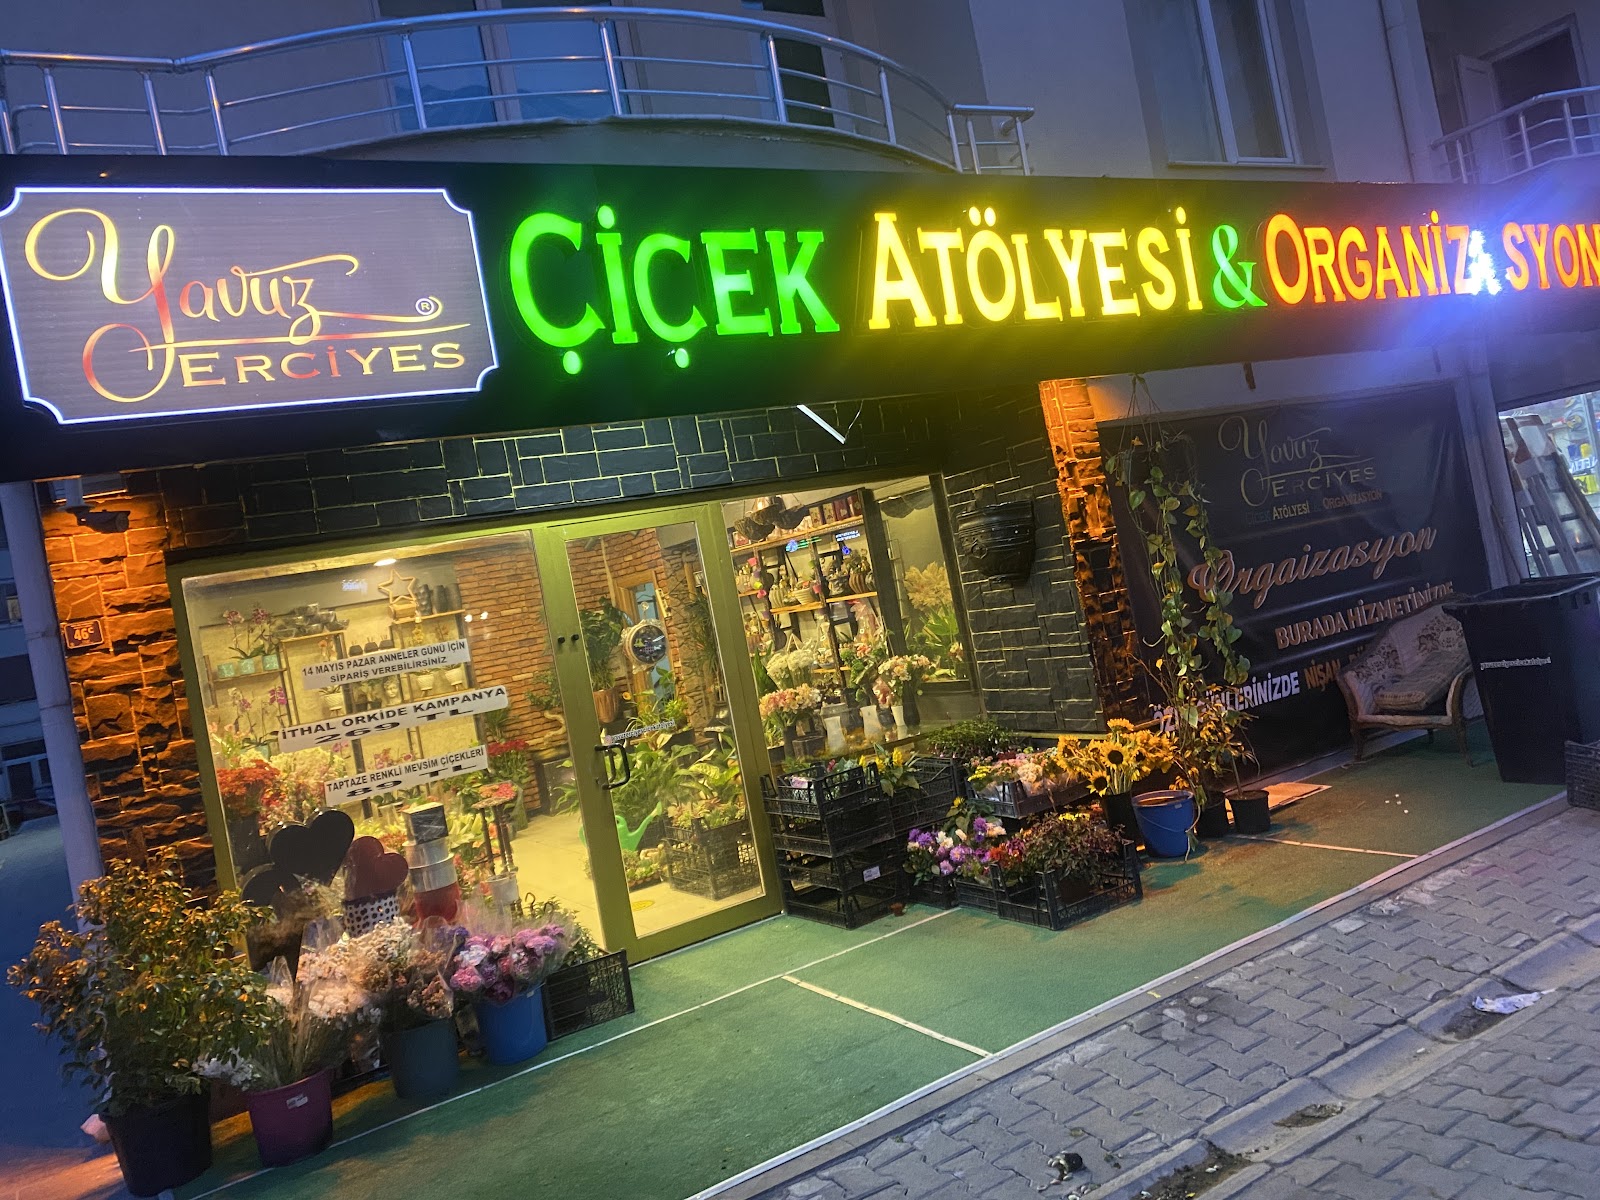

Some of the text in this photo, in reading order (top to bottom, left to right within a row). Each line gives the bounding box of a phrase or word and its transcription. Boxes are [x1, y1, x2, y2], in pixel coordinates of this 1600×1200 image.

[25, 208, 358, 402] Yavuz
[510, 205, 840, 374] ÇİÇEK
[869, 206, 1203, 330] ATÖLYESİ
[1211, 224, 1268, 309] &
[180, 342, 465, 388] ERCİYES
[1272, 466, 1377, 499] ERCİYES
[1187, 526, 1438, 610] Orgaizasyon
[1275, 581, 1454, 650] BURADA HİZMETİNİZDE
[302, 640, 466, 677] 14 MAYIS PAZAR ANNELER GÜNÜ İÇİN
[330, 656, 448, 684] SİPARİŞ VEREBİLİRSİNİZ
[281, 687, 506, 740] İTHAL ORKİDE KAMPANYA
[315, 708, 475, 744] 269 TL
[326, 747, 484, 793] TAPTAZE RENKLİ MEVSİM ÇİÇEKLERİ
[418, 764, 477, 778] TL
